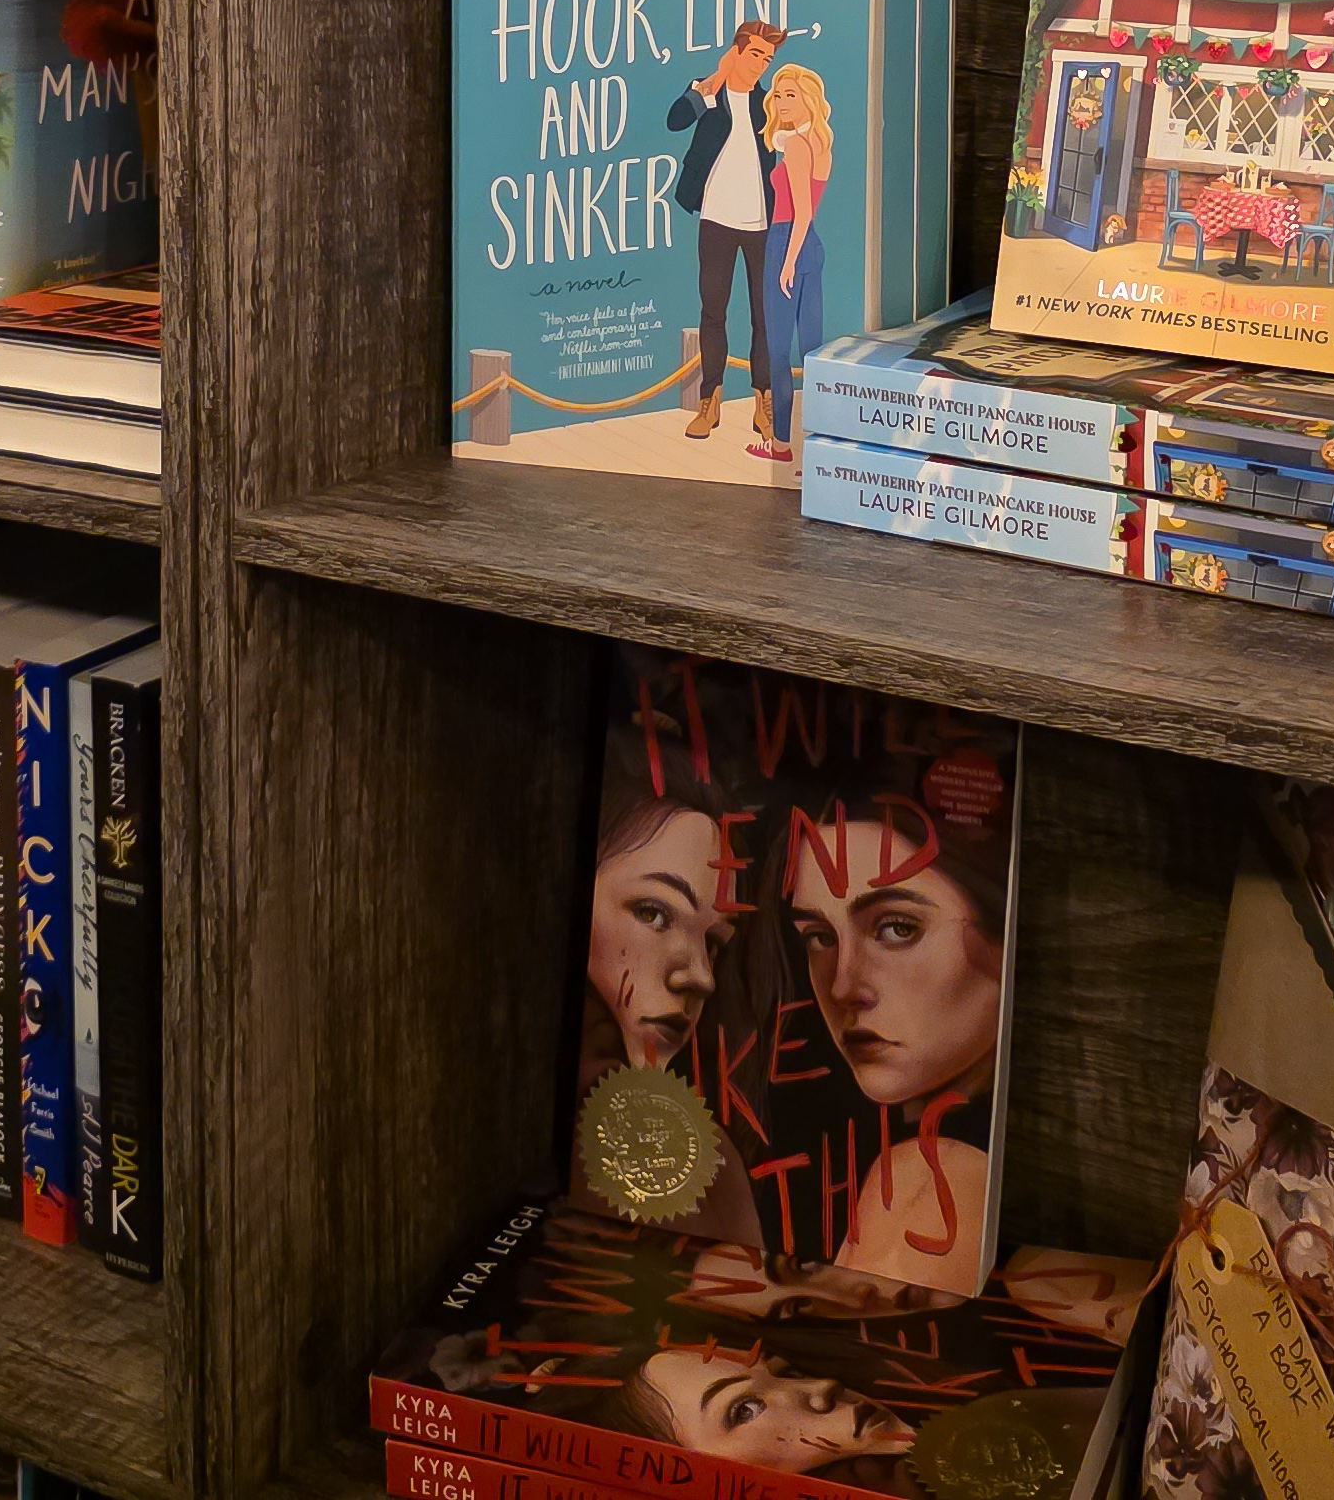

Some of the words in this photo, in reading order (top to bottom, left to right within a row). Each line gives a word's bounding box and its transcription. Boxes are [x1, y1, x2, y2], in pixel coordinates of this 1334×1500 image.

[539, 76, 628, 160] AND
[486, 153, 678, 270] SINKER
[1015, 295, 1032, 310] #1
[1037, 296, 1080, 313] NEW
[1085, 302, 1133, 320] YORK
[1140, 307, 1197, 328] TIMES
[1200, 315, 1329, 345] BESTSELLING
[816, 382, 833, 395] The
[834, 384, 926, 407] STRAWBERRY
[928, 399, 974, 418] PATCH
[977, 405, 1045, 428] PANCAKE
[1047, 414, 1097, 436] HOUSE
[858, 404, 938, 437] LAURIE
[944, 419, 1050, 454] GILMORE
[107, 700, 127, 808] BRACKEN
[709, 793, 943, 914] END
[750, 1090, 972, 1260] THIS
[1192, 1279, 1272, 1450] PSYCHOLOGICAL
[1252, 1311, 1270, 1333] A
[1269, 1344, 1307, 1416] BOOK
[1289, 1335, 1329, 1410] DATE
[391, 1412, 458, 1444] LEIGH
[394, 1391, 455, 1421] KYRA
